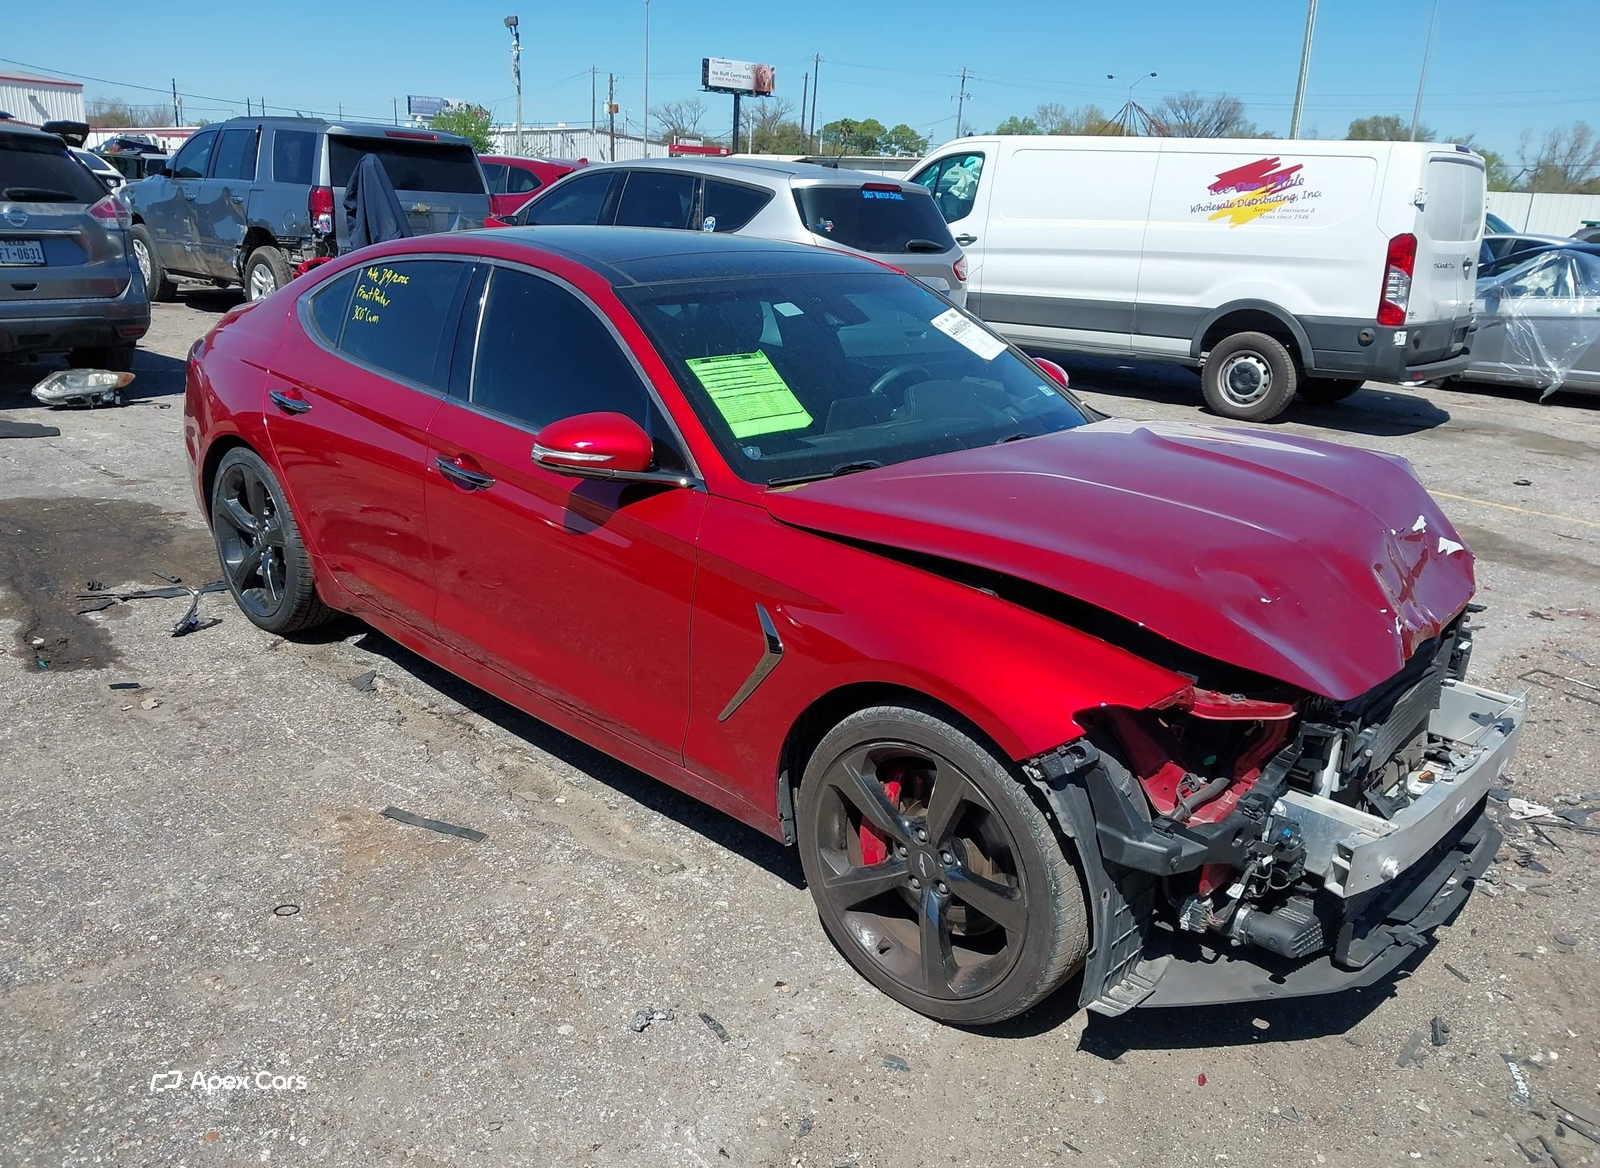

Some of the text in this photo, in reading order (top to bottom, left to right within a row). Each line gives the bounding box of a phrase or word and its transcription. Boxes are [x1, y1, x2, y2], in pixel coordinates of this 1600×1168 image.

[1190, 190, 1322, 214] Wholesale Distributing, Inc.
[1253, 206, 1276, 215] Serving
